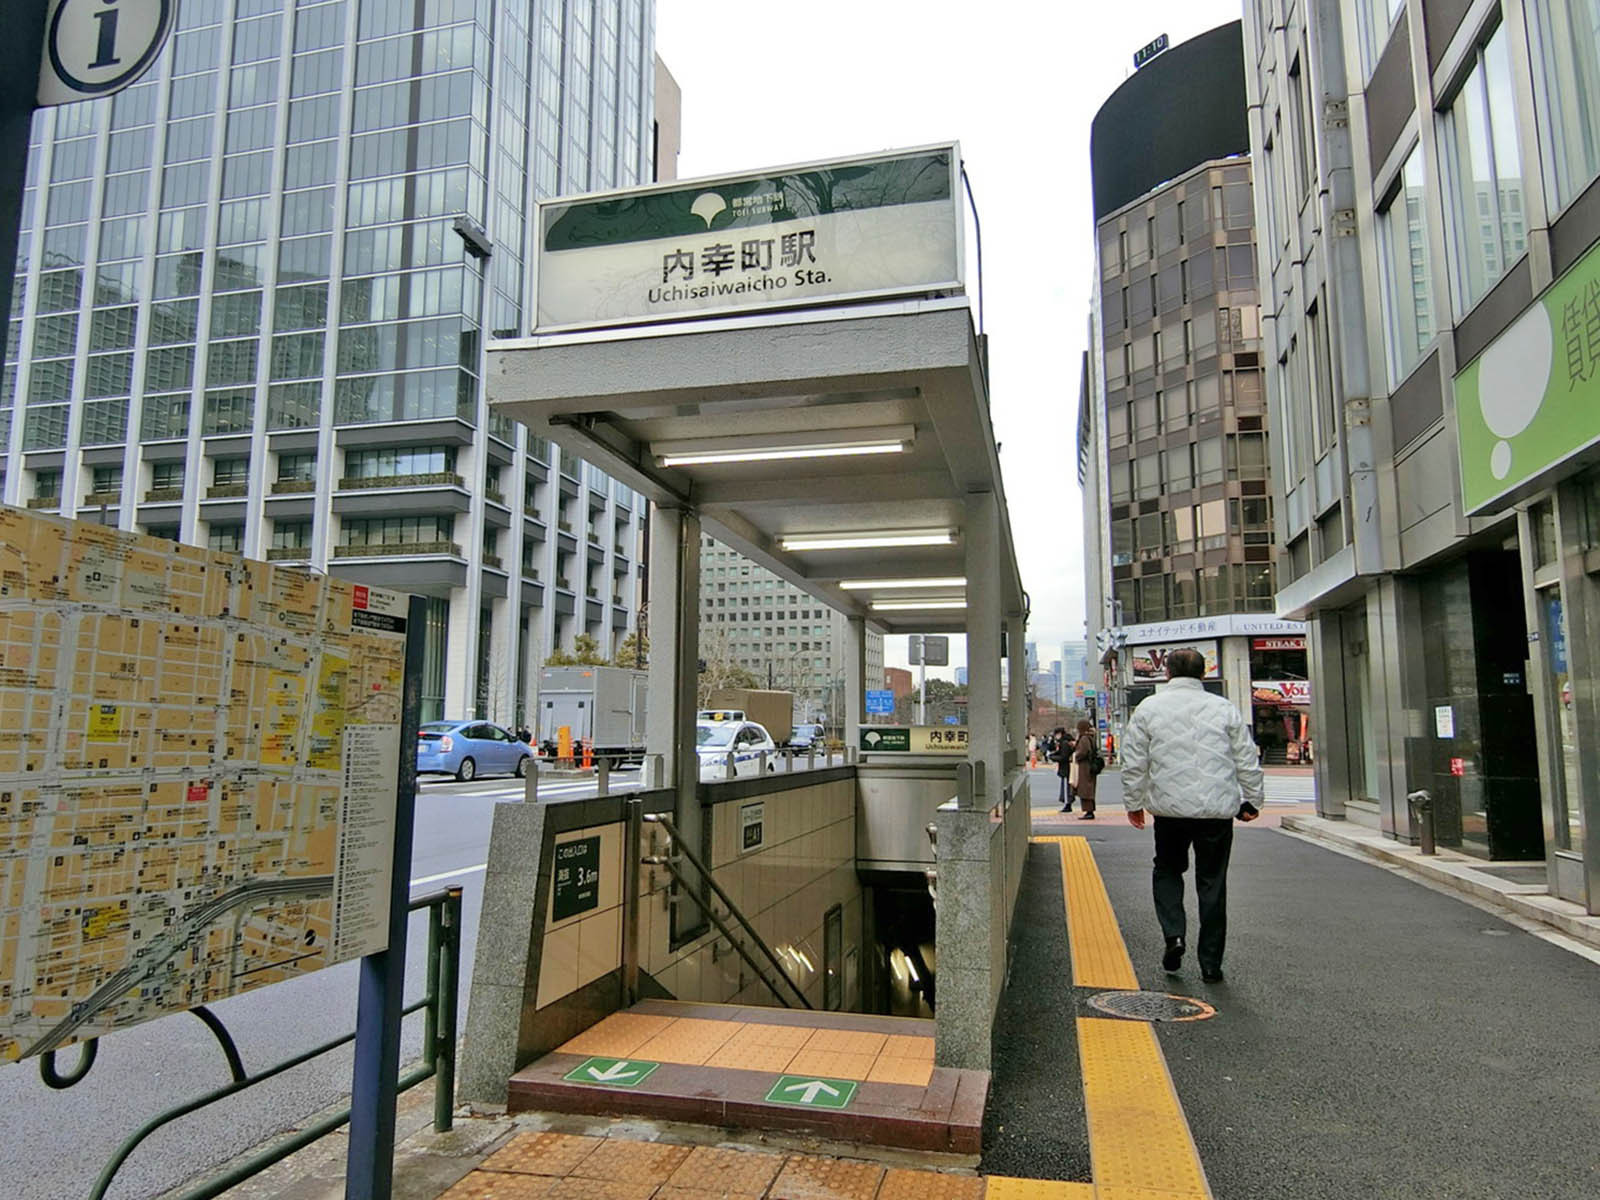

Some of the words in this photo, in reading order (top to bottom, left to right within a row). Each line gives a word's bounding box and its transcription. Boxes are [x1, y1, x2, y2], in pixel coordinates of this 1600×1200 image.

[1136, 36, 1164, 63] 11:10
[662, 230, 817, 284] 内幸町駅
[648, 274, 788, 304] Uchisaiwaicho
[794, 269, 833, 287] Sta.
[1243, 622, 1283, 631] UNITED
[1265, 640, 1297, 648] STEAK
